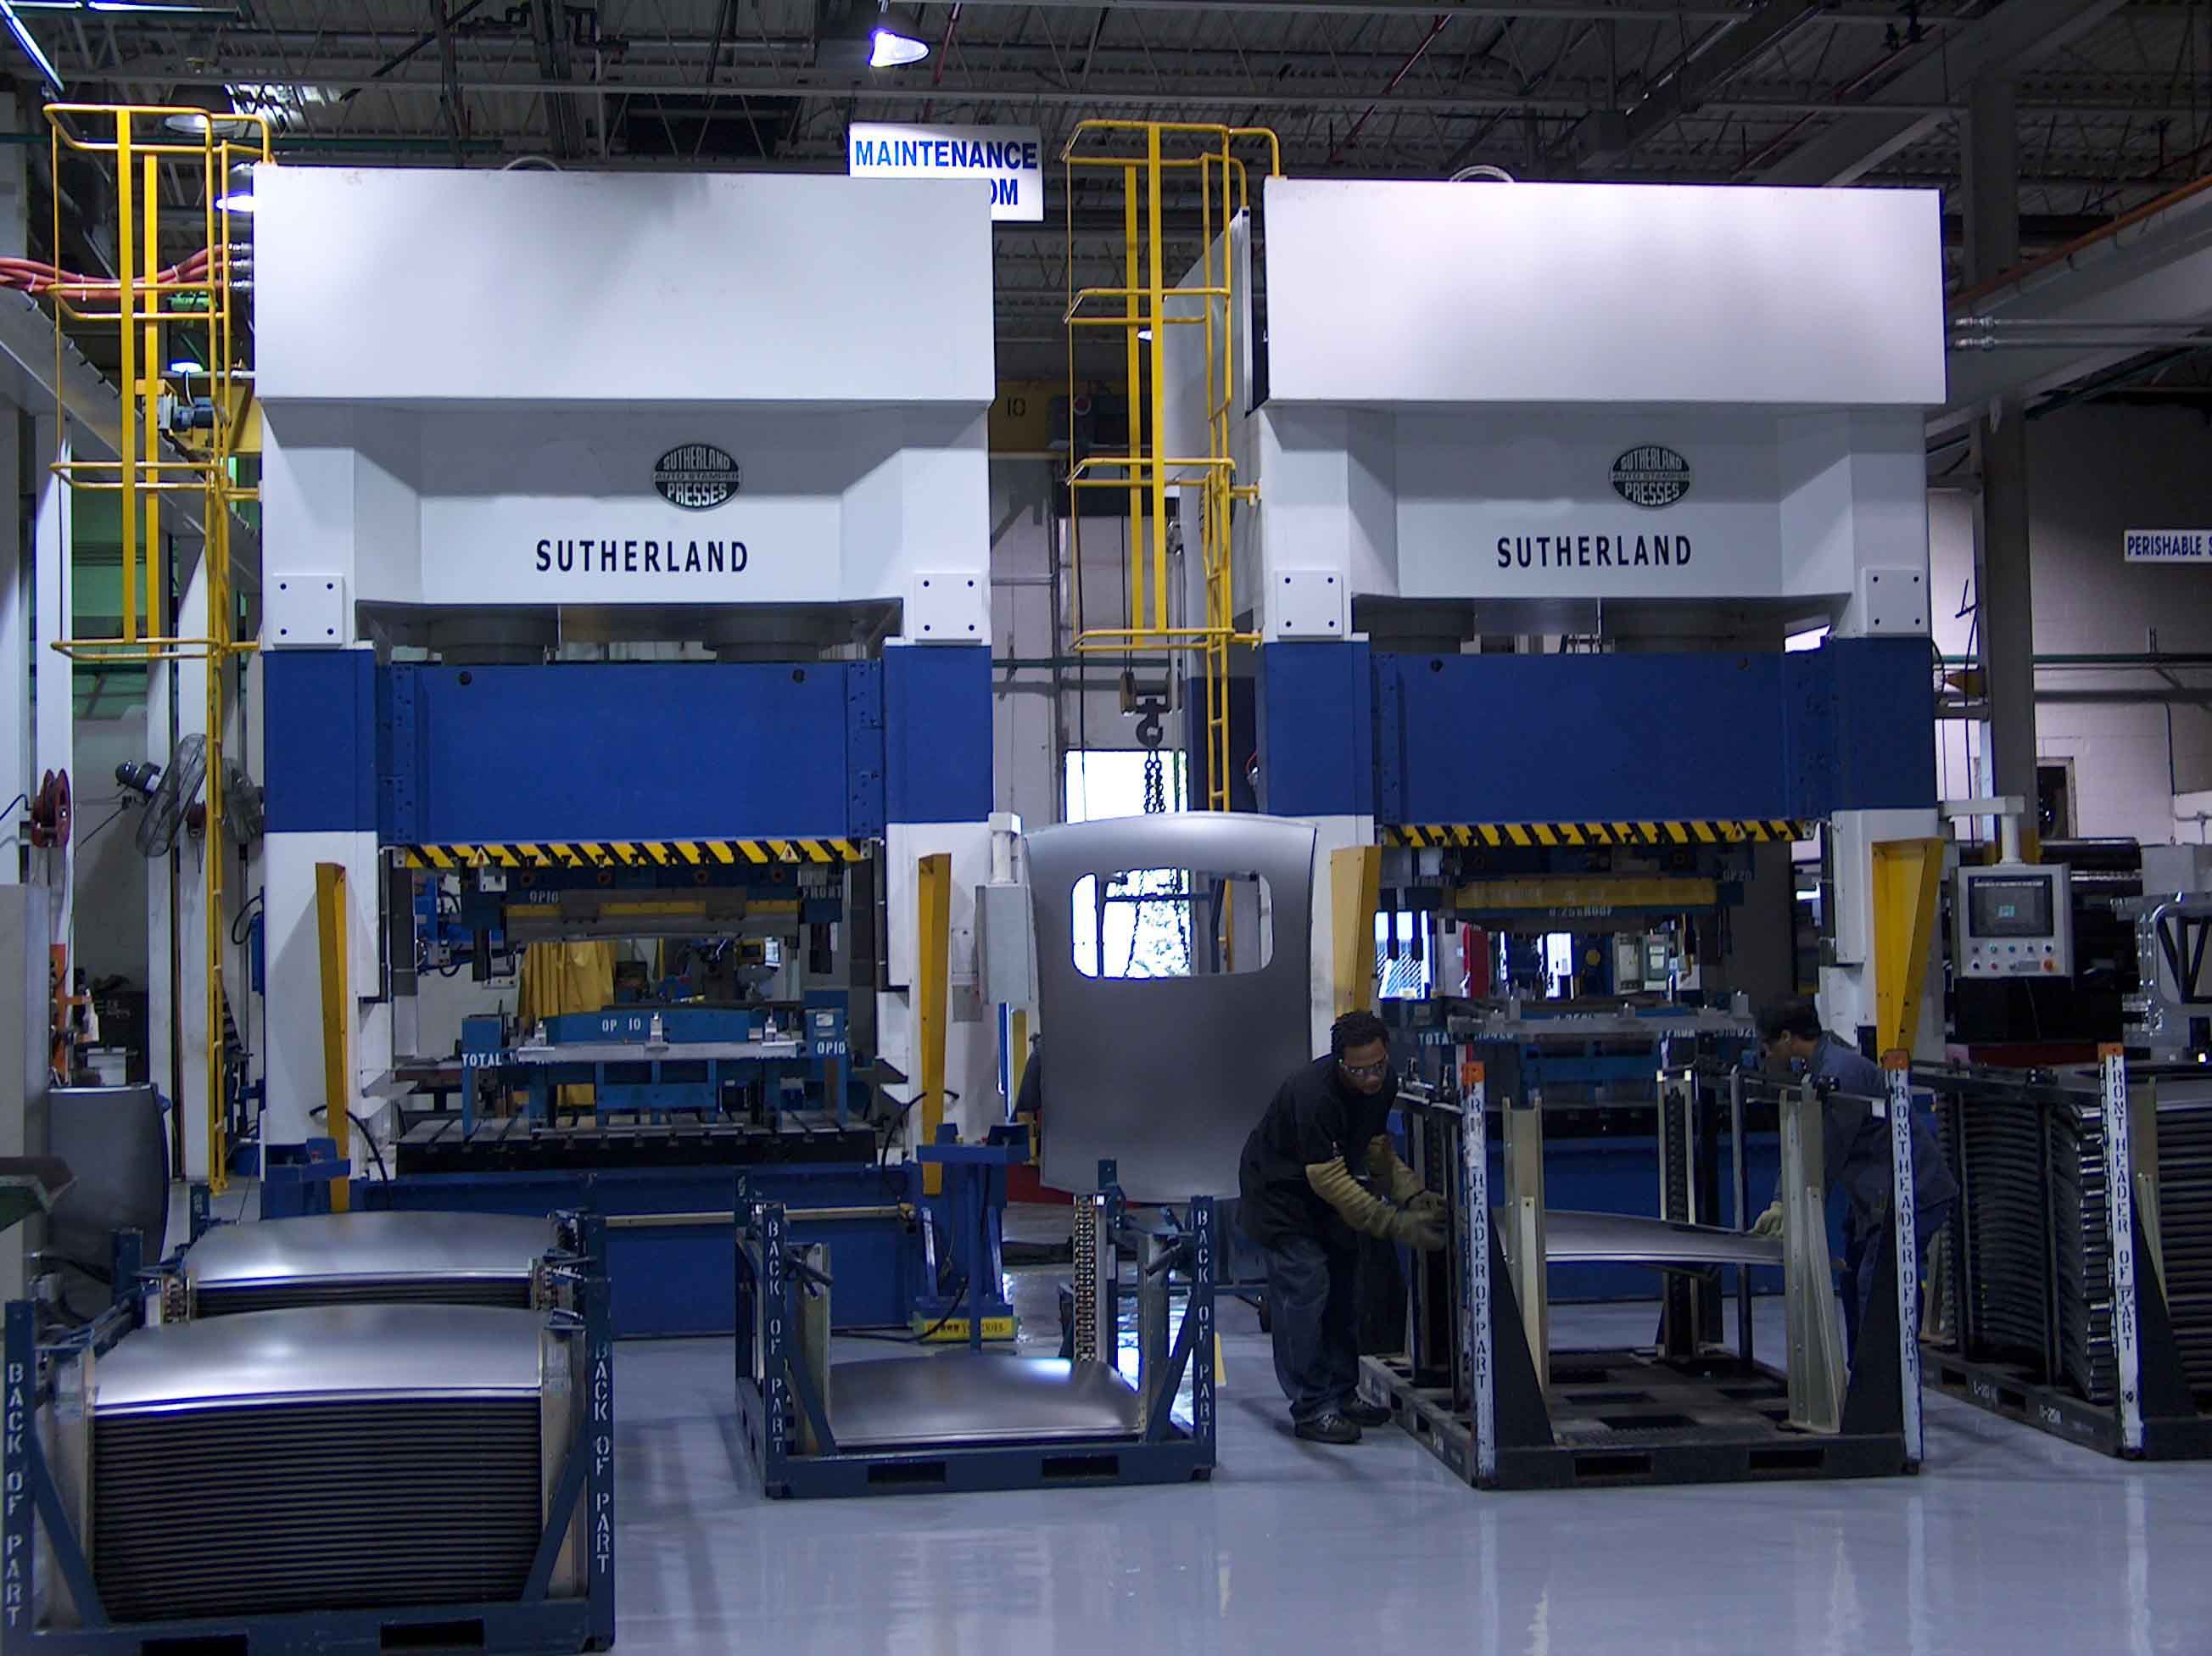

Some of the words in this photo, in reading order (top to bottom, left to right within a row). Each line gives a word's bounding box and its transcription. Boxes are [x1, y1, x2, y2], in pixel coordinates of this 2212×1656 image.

[855, 140, 1038, 169] MAINTENANCE
[663, 446, 730, 470] SUTHERLAND
[1621, 447, 1682, 470] SUTHERLAND
[668, 482, 728, 506] PRESSES
[1625, 482, 1679, 506] PRESSES
[536, 540, 748, 572] SUTHERLAND
[1497, 535, 1691, 567] SUTHERLAND
[2127, 535, 2202, 556] PERISHABLE
[601, 1018, 617, 1032] OP
[628, 1017, 641, 1032] 10
[461, 1053, 502, 1066] TOTAL
[817, 1041, 846, 1054] OP10
[2116, 1138, 2127, 1233] HEADER
[1473, 1174, 1485, 1278] HEADER
[1900, 1160, 1913, 1263] HEADER
[768, 1222, 780, 1295] BACK
[1198, 1210, 1209, 1284] BACK
[2120, 1250, 2129, 1279] OF
[1477, 1285, 1486, 1317] OF
[1904, 1271, 1913, 1301] OF
[770, 1318, 780, 1356] OF
[1198, 1306, 1209, 1342] OF
[1905, 1307, 1916, 1372] PART
[2121, 1290, 2131, 1351] PART
[1477, 1323, 1487, 1389] PART
[595, 1343, 609, 1422] BACK
[1199, 1364, 1209, 1436] PART
[8, 1362, 25, 1453] BACK
[772, 1378, 783, 1453] PART
[596, 1435, 610, 1476] OF
[8, 1471, 24, 1516] OF
[596, 1493, 610, 1574] PART
[7, 1534, 24, 1626] PART
